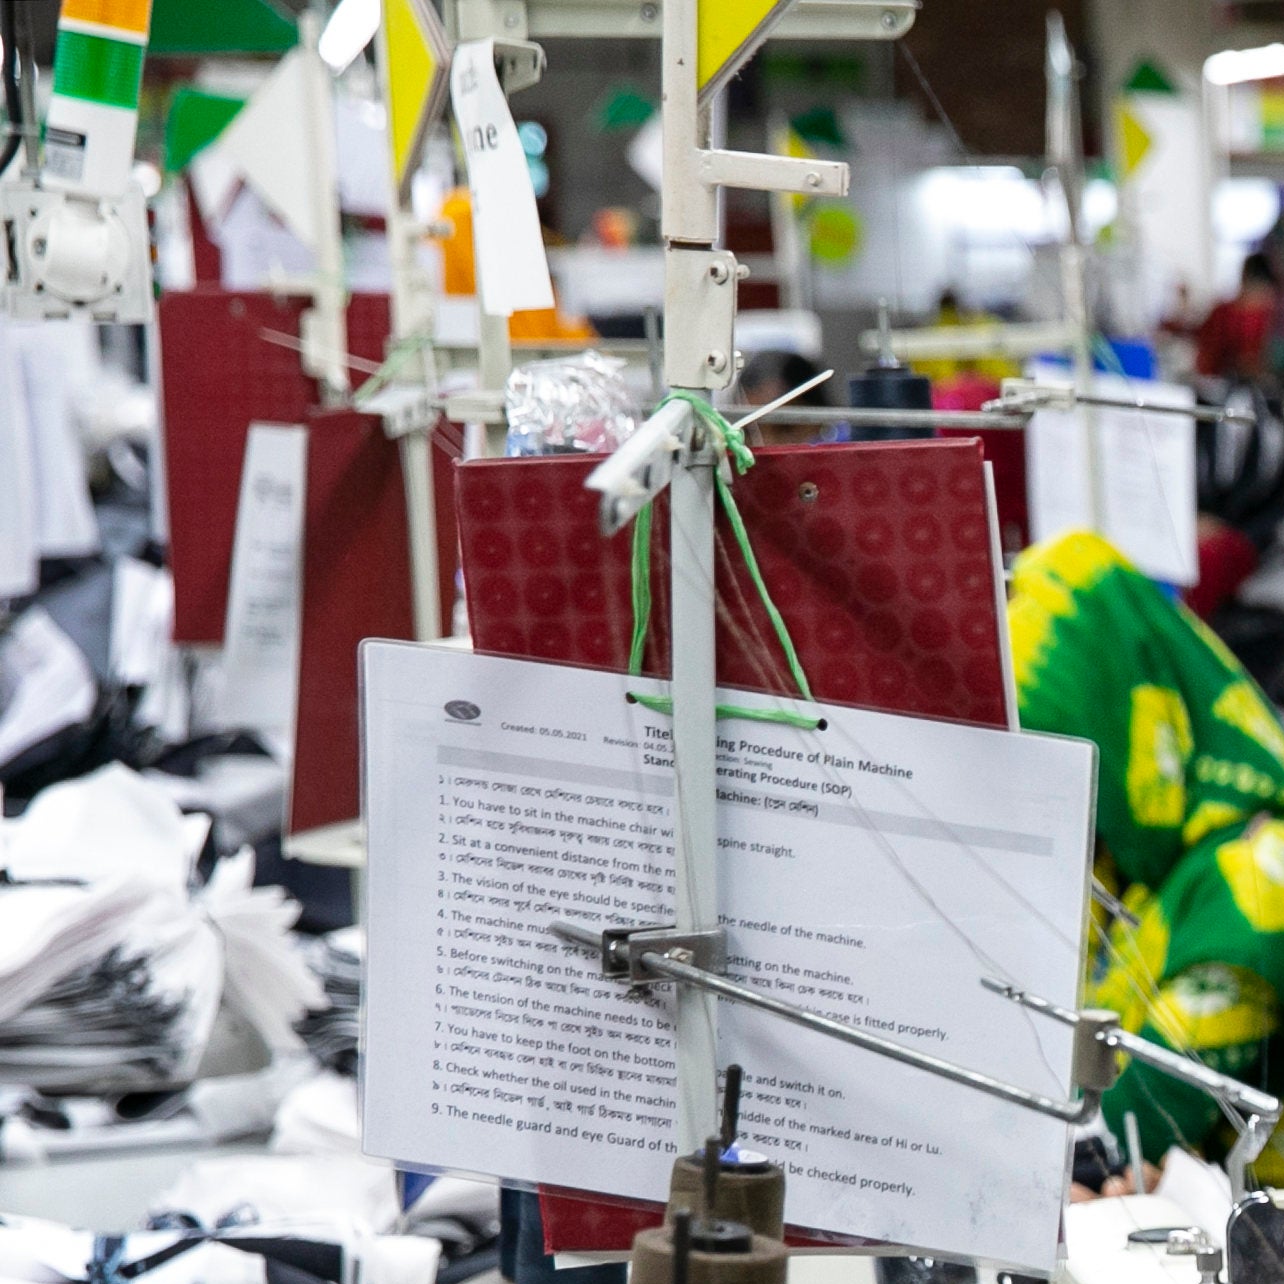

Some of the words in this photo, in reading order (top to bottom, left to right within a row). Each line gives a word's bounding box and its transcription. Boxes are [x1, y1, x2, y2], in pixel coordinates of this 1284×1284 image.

[500, 721, 538, 734] Created:
[539, 727, 586, 741] 05.05.2021
[739, 740, 803, 761] Procedure
[806, 752, 820, 763] of
[823, 754, 854, 768] Plain
[858, 760, 913, 779] Machine
[759, 772, 817, 791] Procedure
[820, 782, 852, 798] (SOP)
[438, 832, 448, 843] 2.
[452, 834, 466, 846] Sit
[469, 839, 481, 848] at
[484, 841, 491, 850] a
[494, 843, 558, 859] convenient
[561, 850, 609, 867] distance
[612, 857, 639, 871] from
[642, 862, 662, 876] the
[439, 794, 448, 805] 1.
[452, 796, 474, 809] You
[477, 799, 506, 813] have
[508, 804, 521, 816] to
[523, 807, 537, 818] sit
[540, 808, 551, 819] in
[554, 810, 574, 823] the
[577, 816, 626, 831] machine
[628, 822, 657, 835] chair
[716, 837, 747, 850] spine
[750, 843, 795, 858] straight.
[437, 870, 448, 881] 3.
[451, 872, 472, 885] The
[475, 876, 509, 890] vision
[511, 881, 524, 892] of
[526, 883, 546, 896] the
[549, 889, 569, 900] eye
[572, 891, 610, 906] should
[613, 896, 628, 909] be
[717, 913, 736, 928] the
[739, 919, 777, 933] needle
[780, 924, 792, 935] of
[794, 927, 813, 939] the
[815, 932, 865, 948] machine.
[436, 908, 447, 919] 4.
[450, 909, 472, 923] The
[475, 916, 524, 931] machine
[764, 962, 779, 972] on
[781, 963, 800, 976] the
[803, 969, 853, 985] machine.
[435, 983, 445, 994] 6.
[448, 985, 469, 998] The
[472, 990, 514, 1005] tension
[516, 997, 529, 1008] of
[531, 999, 550, 1011] the
[553, 1005, 601, 1020] machine
[604, 1013, 638, 1026] needs
[641, 1017, 653, 1028] to
[656, 1017, 671, 1031] be
[436, 945, 446, 956] 5.
[450, 948, 488, 963] Before
[490, 956, 544, 974] switching
[546, 965, 561, 974] on
[564, 966, 583, 978] the
[852, 1015, 862, 1025] is
[864, 1015, 895, 1031] fitted
[897, 1024, 949, 1041] properly.
[434, 1020, 443, 1032] 7.
[447, 1023, 468, 1036] You
[471, 1026, 498, 1041] have
[501, 1033, 513, 1043] to
[515, 1034, 543, 1050] keep
[545, 1039, 565, 1052] the
[567, 1042, 591, 1056] foot
[593, 1049, 608, 1059] on
[611, 1050, 630, 1063] the
[633, 1053, 675, 1069] bottom
[755, 1075, 777, 1086] and
[779, 1080, 814, 1093] switch
[817, 1084, 825, 1096] it
[827, 1089, 845, 1099] on.
[432, 1059, 442, 1070] 8.
[445, 1062, 479, 1076] Check
[482, 1069, 528, 1084] whether
[531, 1076, 550, 1089] the
[552, 1080, 567, 1091] oil
[569, 1085, 597, 1096] used
[599, 1087, 610, 1098] in
[613, 1089, 632, 1102] the
[773, 1116, 785, 1127] of
[788, 1119, 806, 1131] the
[809, 1125, 851, 1139] marked
[853, 1132, 878, 1144] area
[880, 1136, 893, 1146] of
[895, 1138, 907, 1149] Hi
[910, 1142, 923, 1151] or
[431, 1102, 442, 1114] 9.
[446, 1104, 468, 1119] The
[471, 1112, 513, 1126] needle
[516, 1120, 551, 1133] guard
[554, 1126, 578, 1137] and
[581, 1130, 603, 1142] eye
[606, 1132, 645, 1148] Guard
[648, 1139, 662, 1151] of
[788, 1161, 803, 1175] be
[806, 1166, 856, 1185] checked
[859, 1178, 915, 1197] properly.
